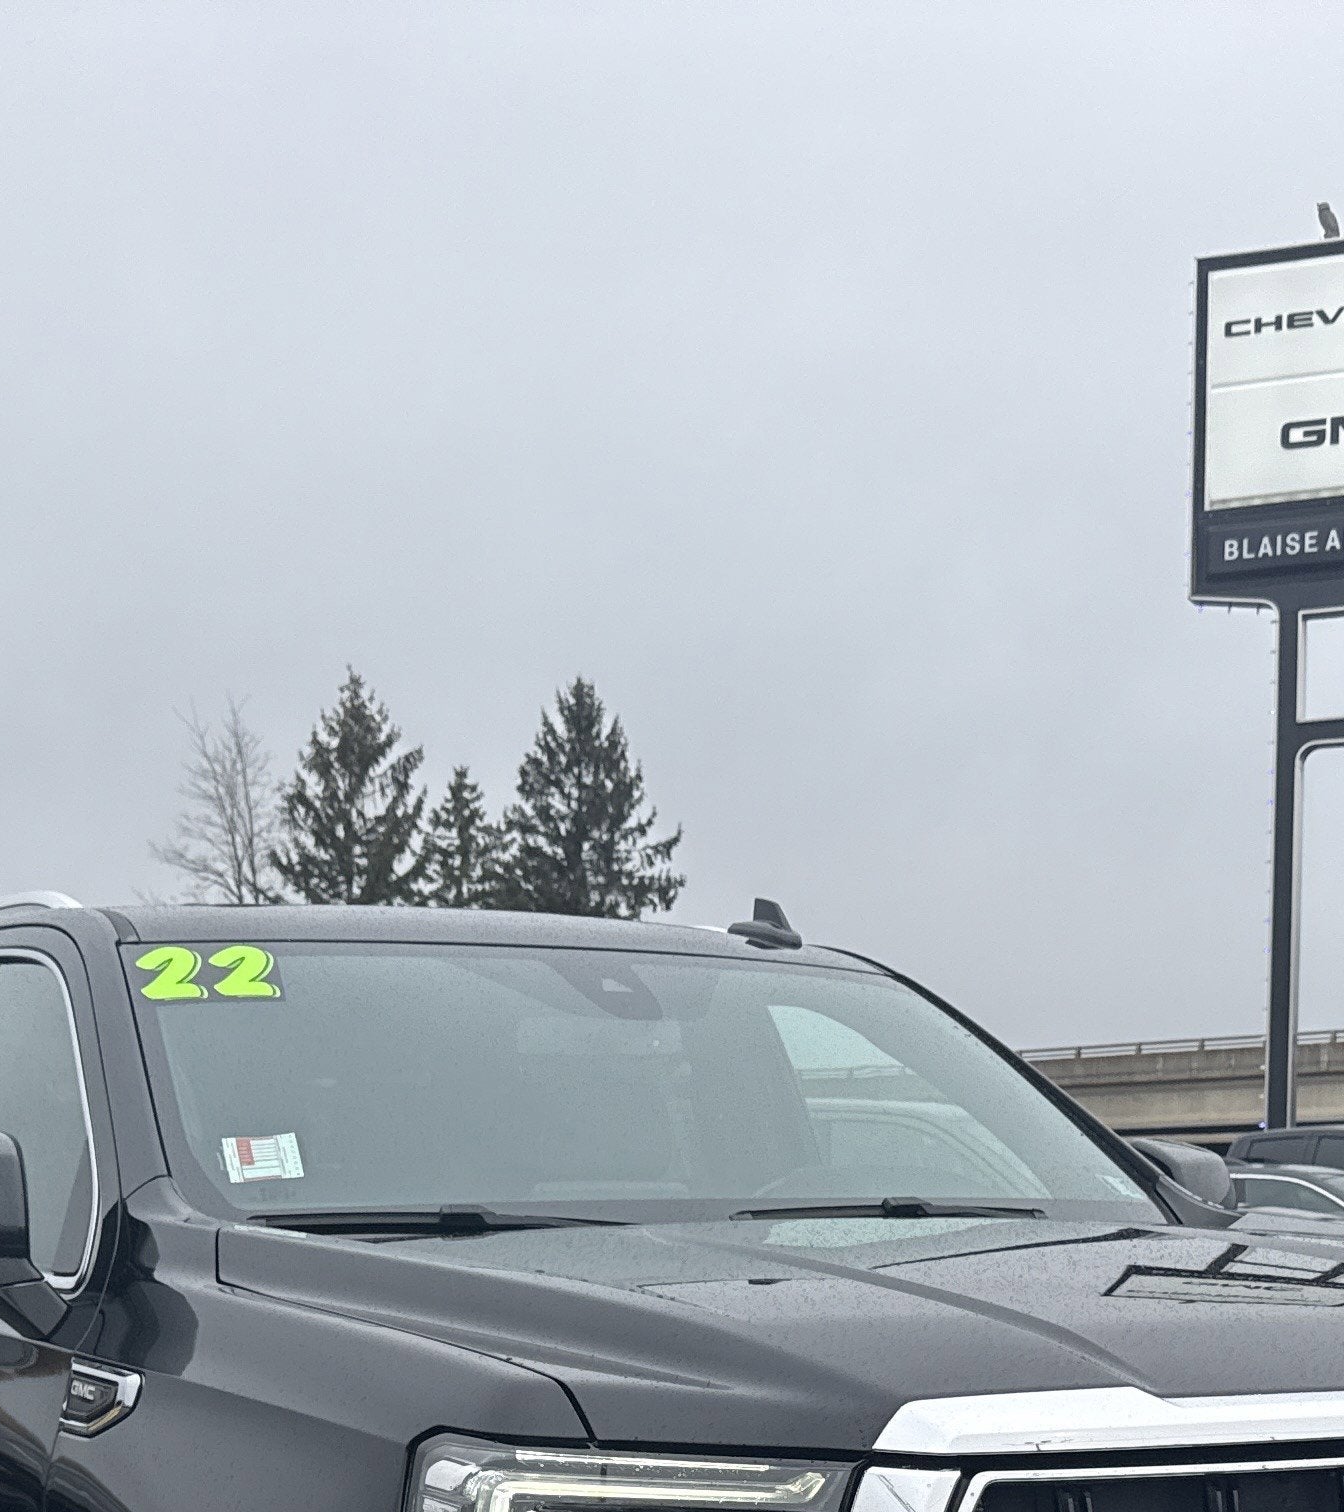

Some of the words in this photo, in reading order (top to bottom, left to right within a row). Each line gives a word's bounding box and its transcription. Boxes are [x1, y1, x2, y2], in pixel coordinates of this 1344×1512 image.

[1223, 530, 1319, 562] BLAISE
[135, 945, 281, 1000] 22
[70, 1379, 96, 1401] GMC
